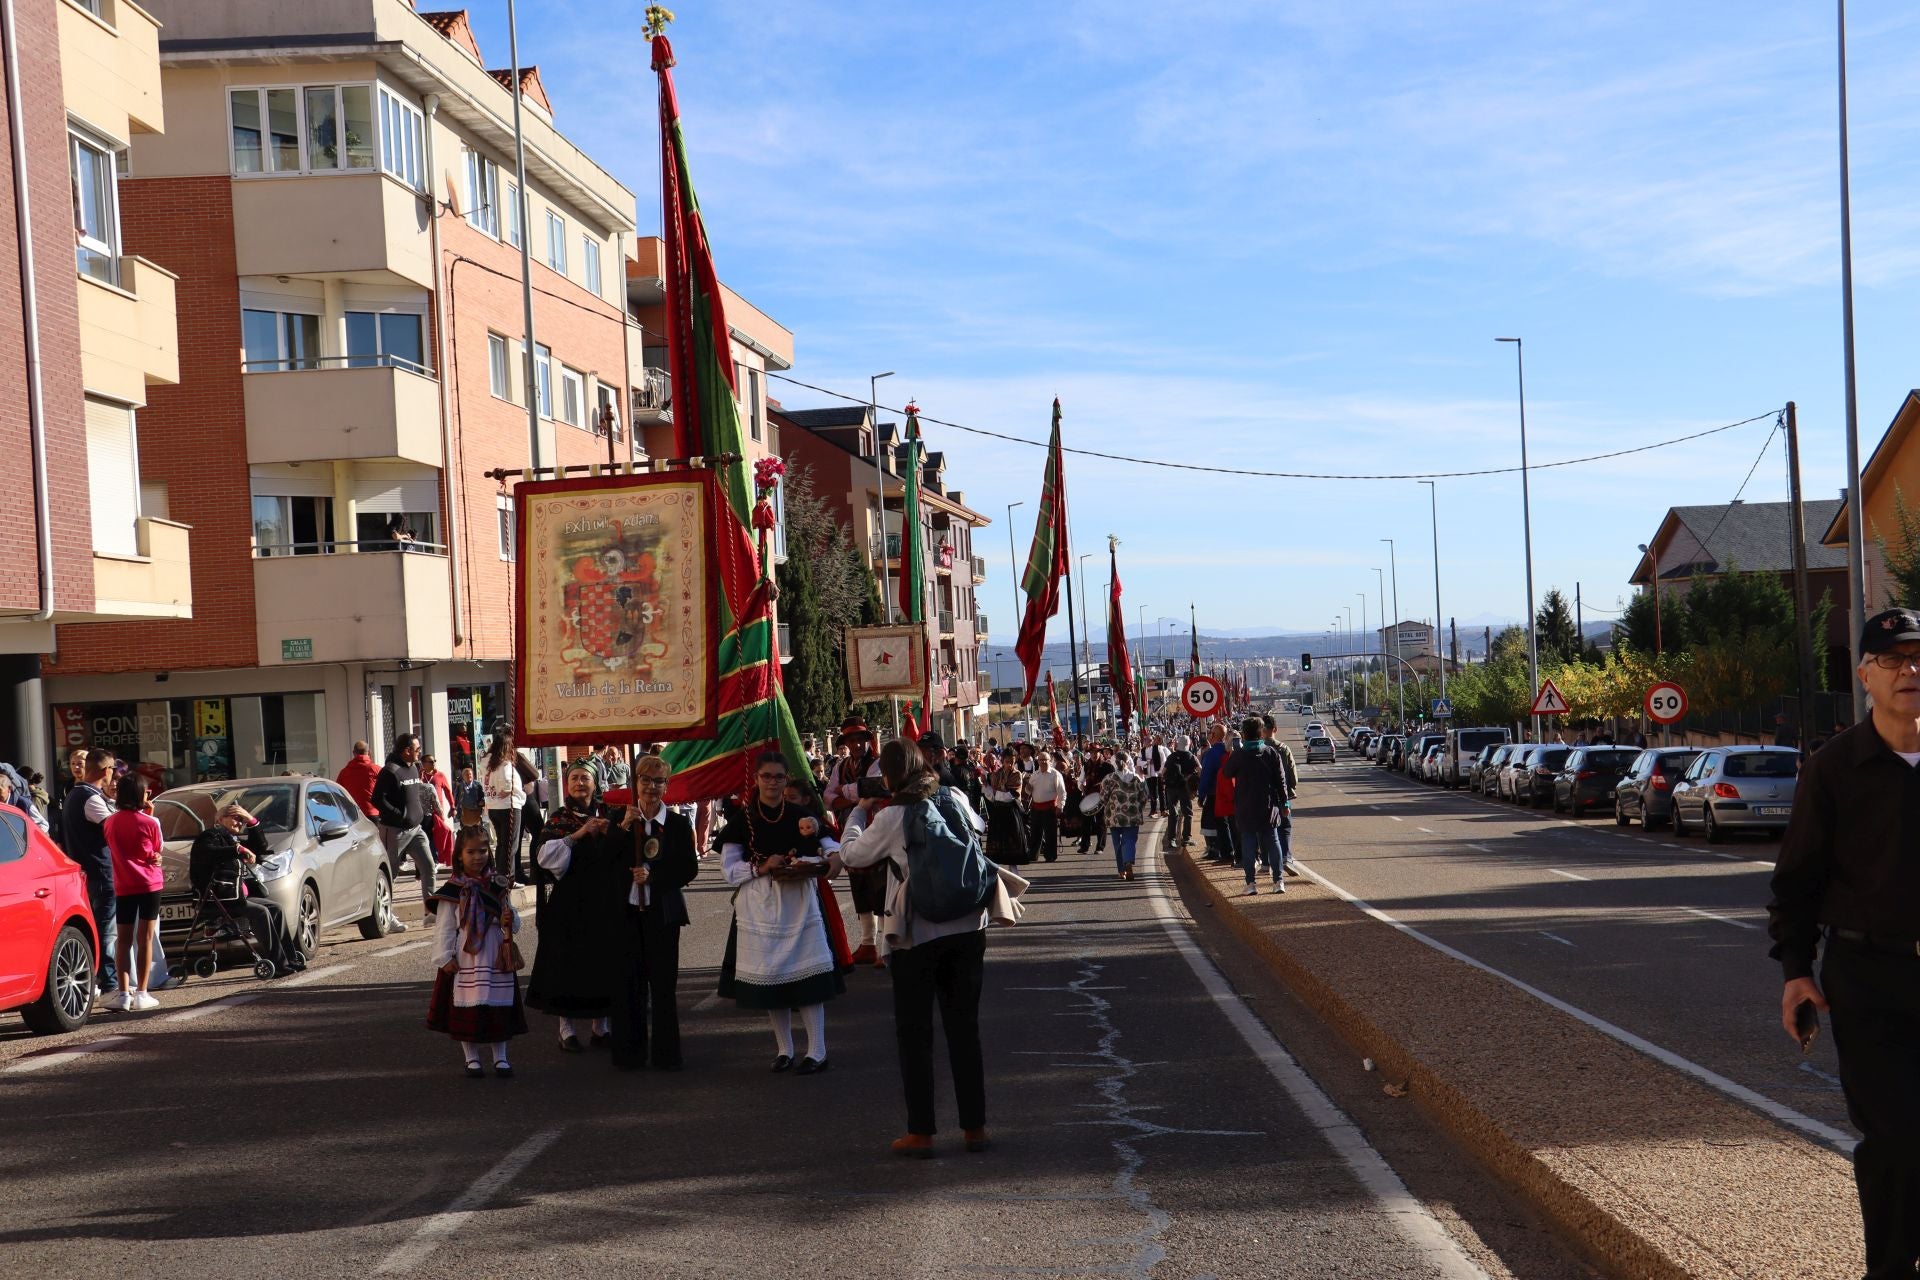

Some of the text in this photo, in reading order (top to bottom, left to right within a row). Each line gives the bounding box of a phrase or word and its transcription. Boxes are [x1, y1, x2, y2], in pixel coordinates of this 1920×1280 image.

[556, 679, 673, 697] Velilla de la Reina
[1191, 690, 1214, 704] 50
[1654, 696, 1678, 710] 50
[92, 713, 182, 735] CONPRO
